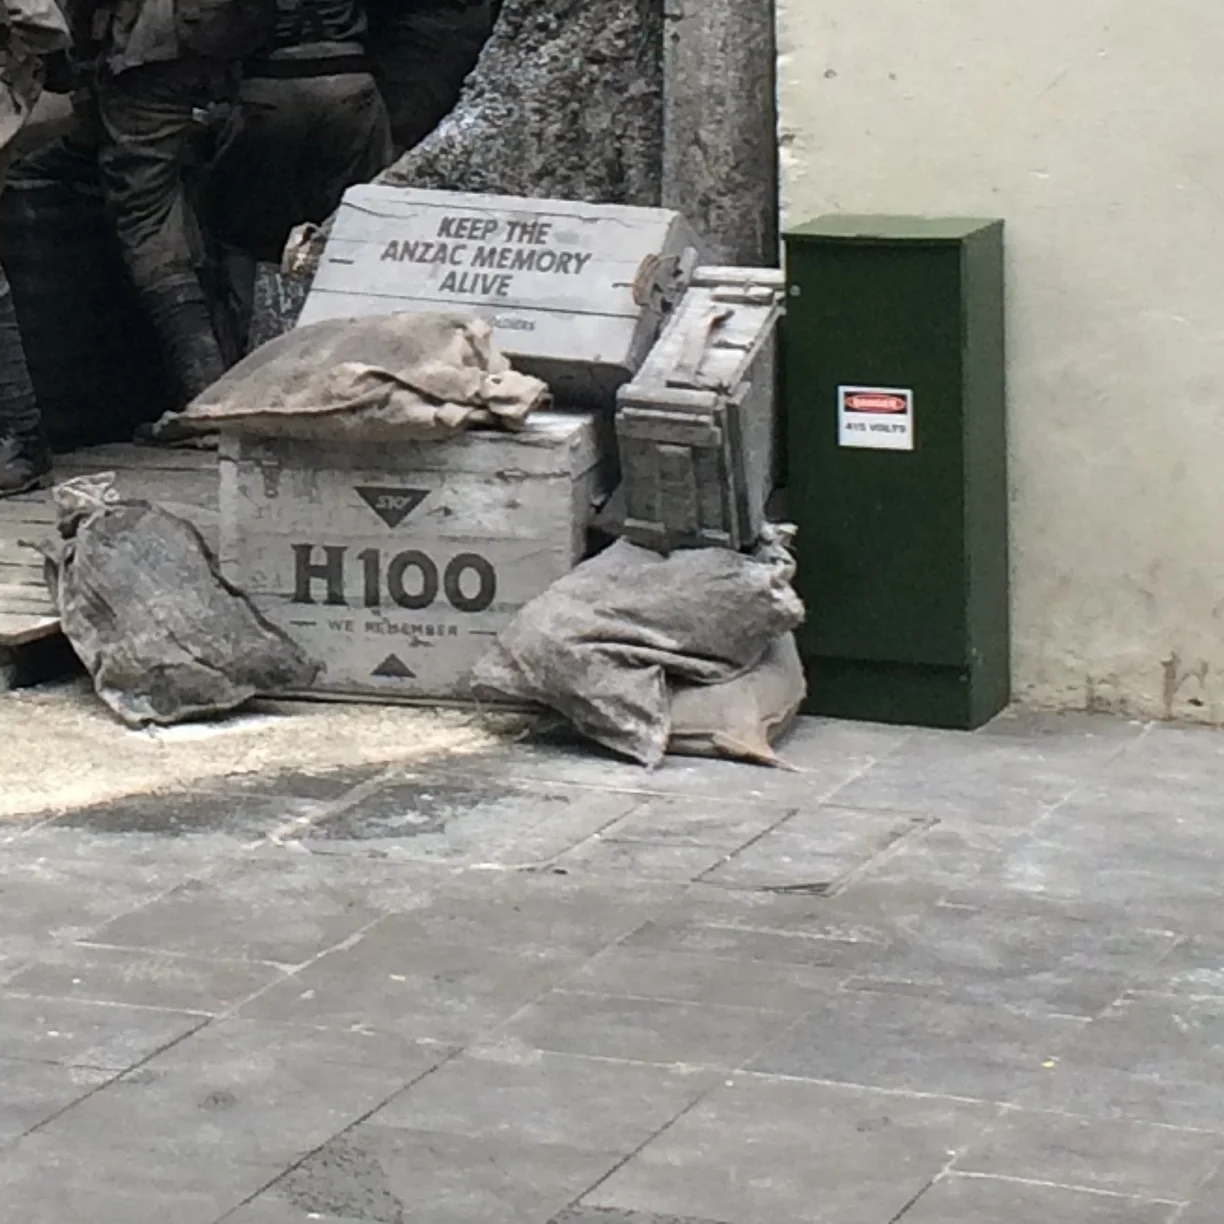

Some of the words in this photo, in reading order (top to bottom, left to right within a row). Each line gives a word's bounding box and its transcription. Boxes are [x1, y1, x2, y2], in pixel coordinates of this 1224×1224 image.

[437, 216, 498, 240] KEEP
[506, 220, 553, 245] THE
[380, 239, 466, 266] ANZAC
[470, 247, 592, 275] MEMORY
[438, 270, 513, 297] ALIVE
[291, 543, 497, 612] H100
[328, 619, 355, 633] WE
[364, 621, 459, 637] REMEMBER
